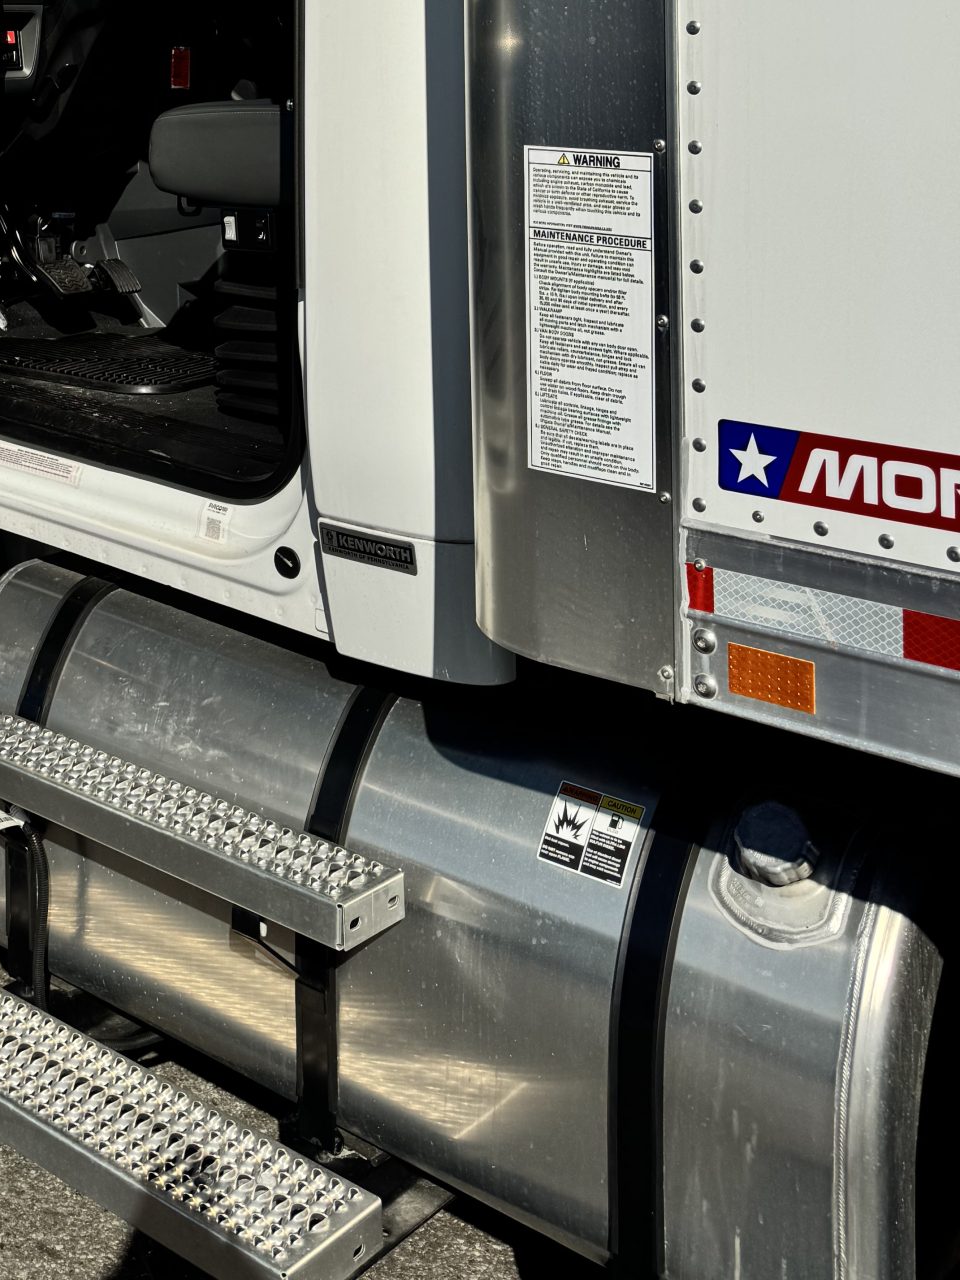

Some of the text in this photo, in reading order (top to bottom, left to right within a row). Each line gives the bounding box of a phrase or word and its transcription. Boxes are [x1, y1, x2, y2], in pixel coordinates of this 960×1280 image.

[572, 153, 620, 168] WARNING
[533, 229, 647, 248] MAINTENANCE PROCEDURE
[338, 534, 410, 561] KENWORTH
[607, 799, 637, 815] CAUTION
